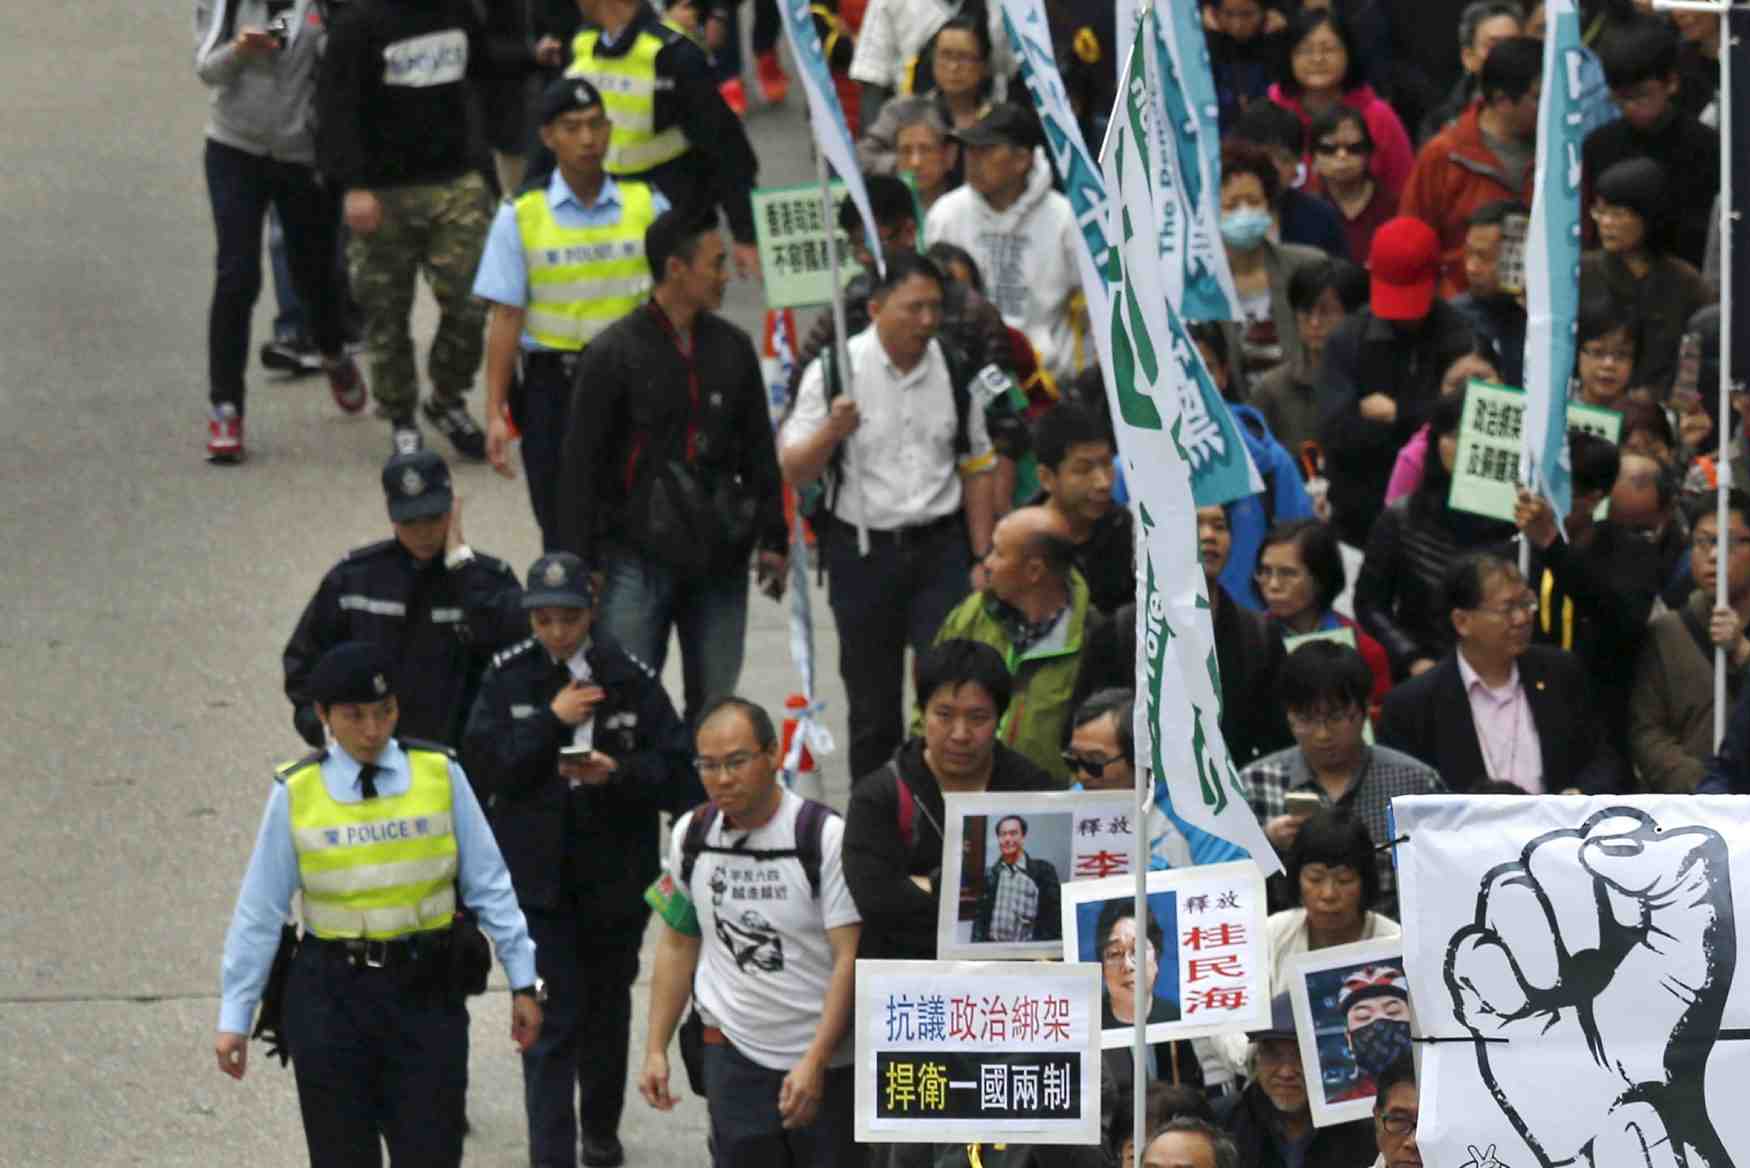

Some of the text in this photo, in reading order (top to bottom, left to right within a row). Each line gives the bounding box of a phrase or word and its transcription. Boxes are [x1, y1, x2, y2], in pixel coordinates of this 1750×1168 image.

[347, 821, 410, 844] POLICE
[1079, 816, 1134, 836] 釋放
[1076, 850, 1129, 878] 李
[1182, 889, 1242, 912] 釋放
[1182, 922, 1249, 1014] 桂民海
[886, 994, 1071, 1043] 抗議政治綁架
[886, 1060, 1071, 1113] 捍衛一國兩制
